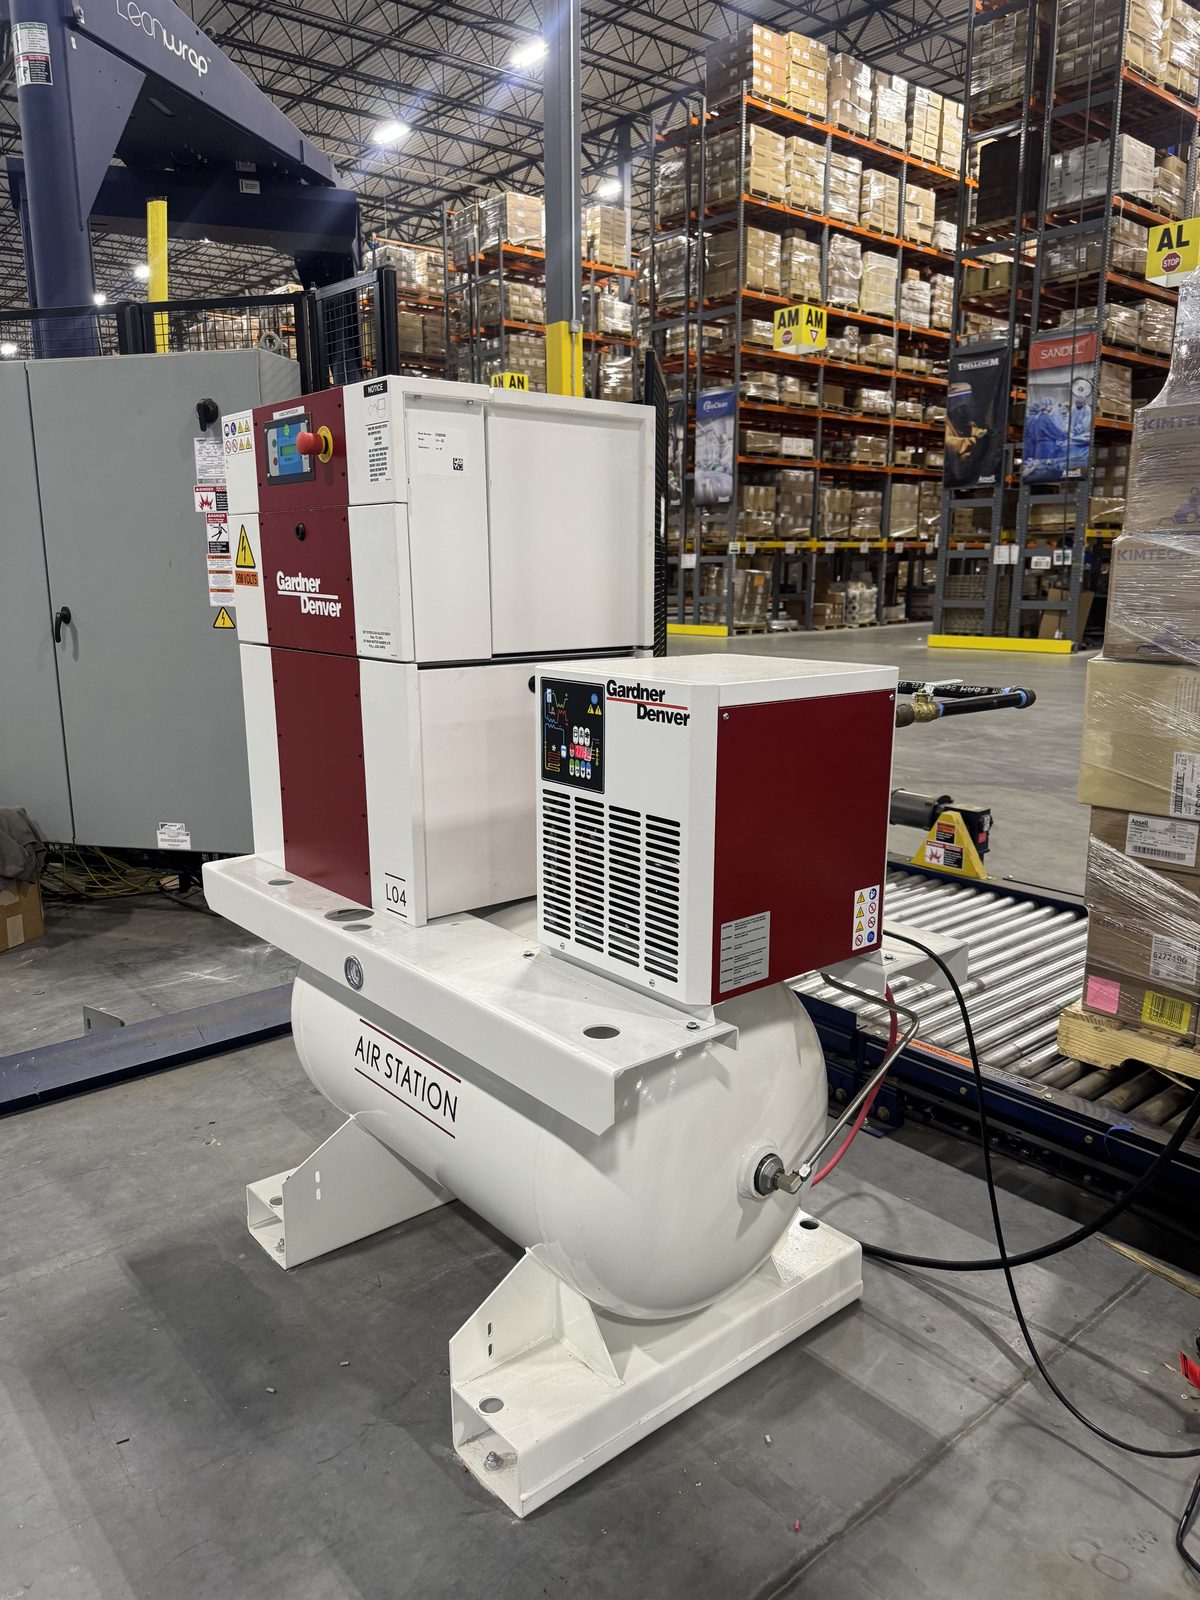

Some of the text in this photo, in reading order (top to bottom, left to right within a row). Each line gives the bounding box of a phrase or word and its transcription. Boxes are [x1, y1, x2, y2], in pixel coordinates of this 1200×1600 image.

[1157, 225, 1190, 252] AL
[1163, 258, 1180, 268] STOP
[777, 308, 800, 330] AM
[805, 308, 824, 330] AM
[367, 383, 384, 394] NOTICE
[493, 375, 504, 389] AN
[509, 375, 525, 390] AN
[276, 570, 321, 593] Gardner
[300, 594, 342, 618] Denver
[606, 679, 666, 702] Gardner
[637, 703, 690, 726] Denver
[1130, 818, 1149, 828] Ansell
[386, 882, 408, 907] L04
[354, 1035, 459, 1123] AIR STATION
